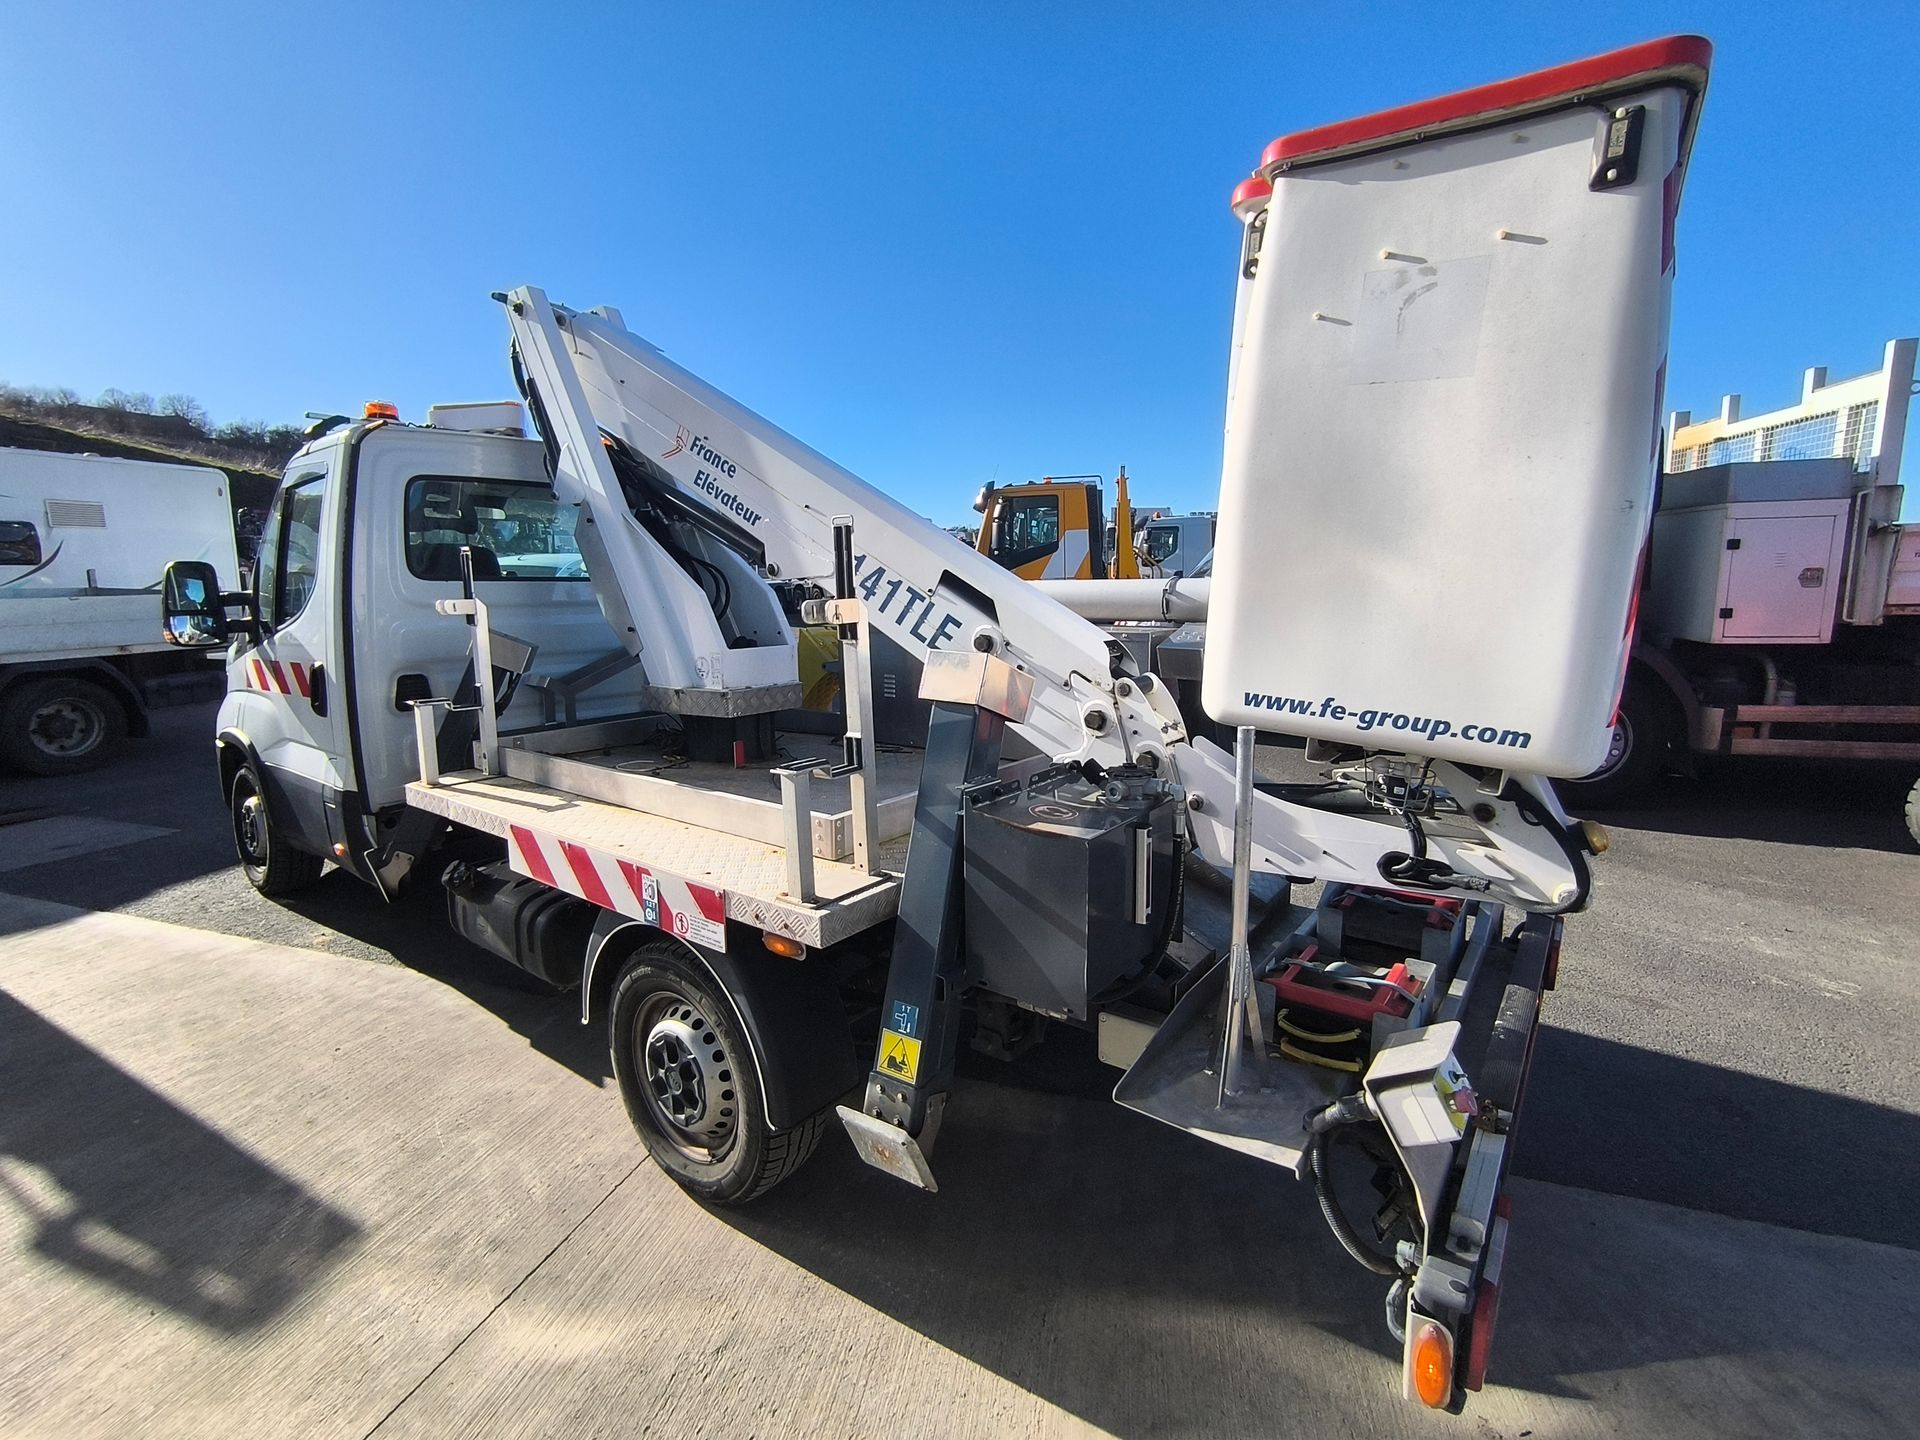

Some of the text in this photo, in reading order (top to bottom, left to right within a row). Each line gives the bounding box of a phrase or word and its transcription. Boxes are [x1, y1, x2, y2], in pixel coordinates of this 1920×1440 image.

[690, 436, 736, 478] France
[694, 470, 762, 527] Elévateur
[1244, 692, 1532, 749] www.fe-group.com
